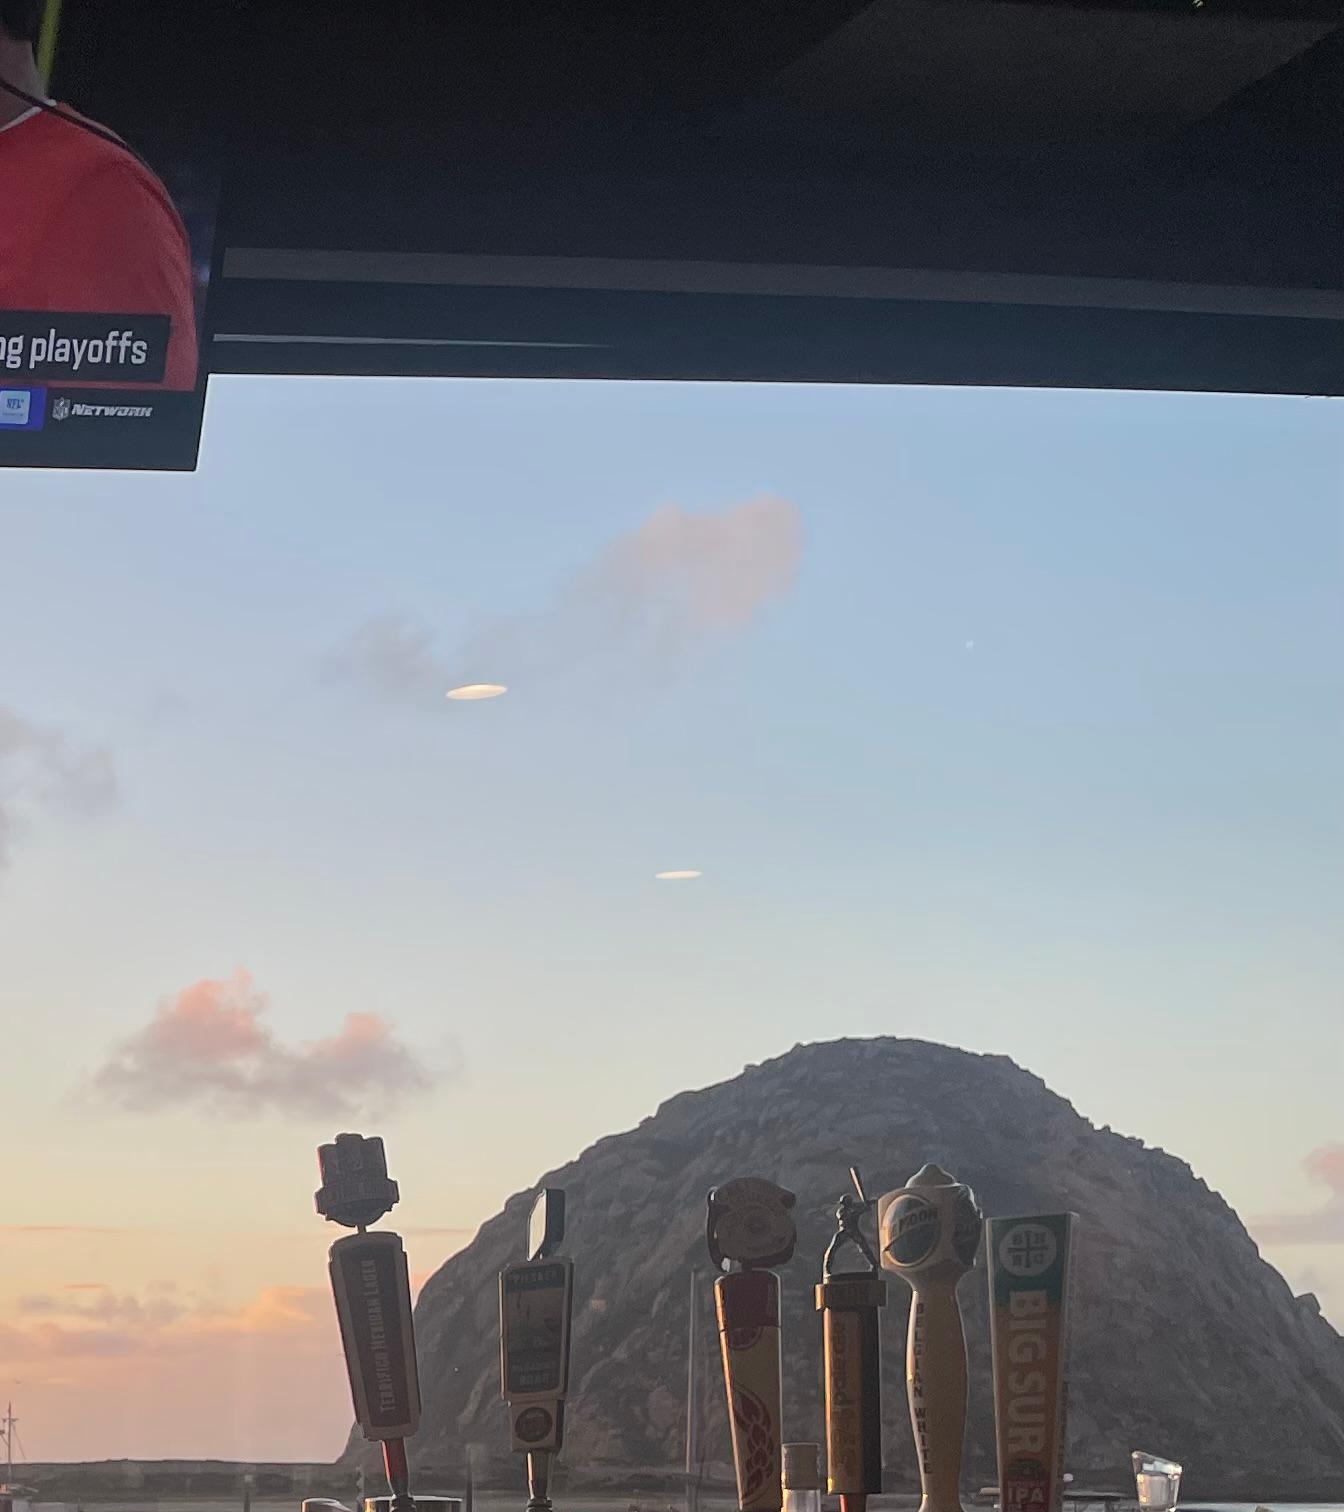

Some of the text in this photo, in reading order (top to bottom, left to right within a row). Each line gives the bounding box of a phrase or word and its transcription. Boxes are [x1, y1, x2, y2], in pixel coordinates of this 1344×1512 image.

[28, 328, 148, 370] playoffs
[72, 404, 153, 417] NETWORK
[899, 1207, 939, 1231] MOON
[361, 1259, 396, 1412] TERRIFICO MEXICAN LAGER
[1008, 1290, 1048, 1364] BIG
[913, 1303, 932, 1474] BELGIAN WHITE
[1008, 1374, 1048, 1453] SUR
[1007, 1487, 1045, 1504] IPA
